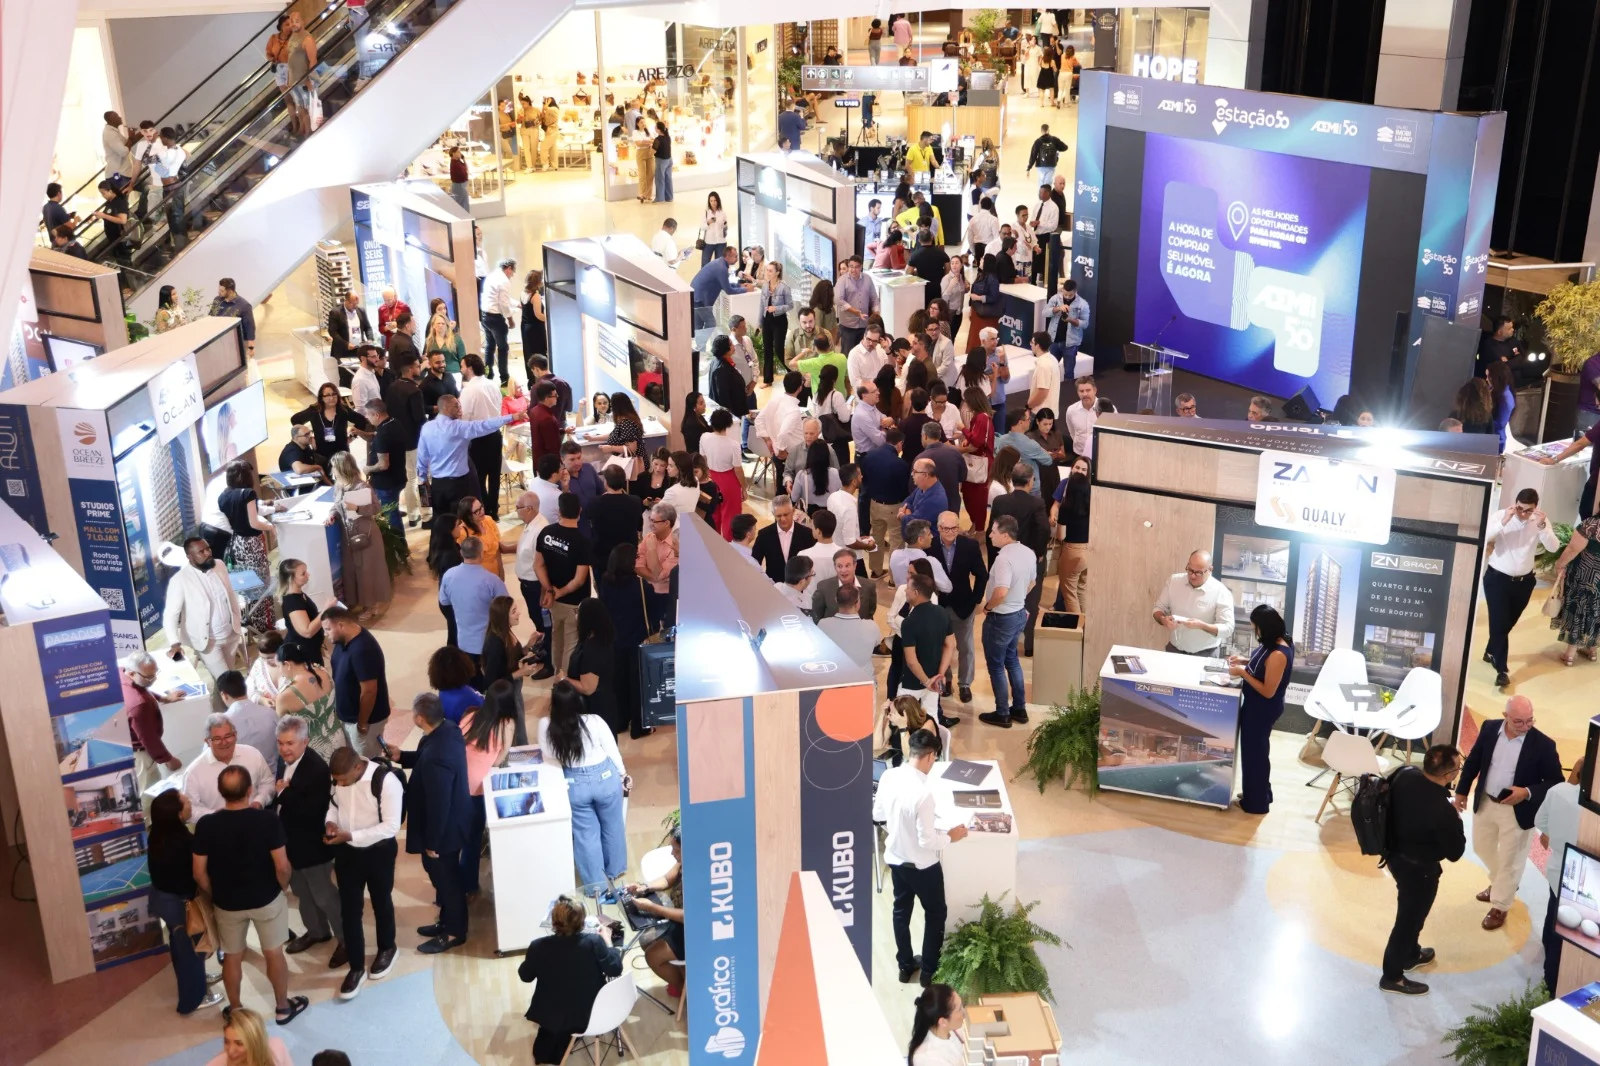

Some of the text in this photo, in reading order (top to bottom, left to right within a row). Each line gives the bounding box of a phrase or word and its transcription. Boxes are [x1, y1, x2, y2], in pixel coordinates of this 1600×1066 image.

[637, 64, 694, 81] AREZZO
[1133, 54, 1198, 84] HOPE
[1157, 98, 1197, 115] ADEMI 50
[1310, 120, 1358, 136] ADEMI 50
[1251, 208, 1299, 223] AS MELHORES
[1169, 222, 1214, 240] A HORA DE
[1251, 217, 1309, 235] OPORTUNIDADES
[1250, 227, 1307, 244] PARA MORAR OU
[1168, 236, 1210, 253] COMPRAR
[365, 249, 383, 259] SEUS
[1074, 255, 1094, 267] ADEMI
[1167, 249, 1216, 270] SEU IMÓVEL
[1424, 252, 1457, 264] estação
[1084, 267, 1093, 278] 50
[1166, 261, 1212, 283] É AGORA
[1443, 264, 1453, 275] 50
[1477, 263, 1484, 274] 50
[1252, 284, 1312, 319] ADEMI
[998, 314, 1021, 331] ADEMI
[1010, 329, 1022, 346] 50
[1285, 316, 1314, 350] 50
[163, 392, 197, 424] OCAN
[1250, 423, 1324, 435] Tenda
[73, 448, 102, 457] OCEAN
[73, 455, 105, 465] BREEZE
[80, 501, 115, 511] STUDIOS
[86, 509, 112, 518] PRIME
[83, 525, 120, 534] MALL COM
[93, 534, 119, 542] LOJAS
[92, 551, 119, 560] Rooftop
[1374, 555, 1439, 571] ZN GRAÇA
[1372, 581, 1403, 590] QUARTO
[1413, 586, 1433, 594] SALA
[1369, 606, 1424, 618] COM ROOFTOP
[45, 626, 103, 646] PARADISE
[55, 665, 108, 680] VARANDA GOURMET
[63, 663, 88, 673] QUARTOS
[1136, 683, 1150, 691] ZN
[832, 831, 854, 902] KUBO
[710, 841, 734, 913] KUBO
